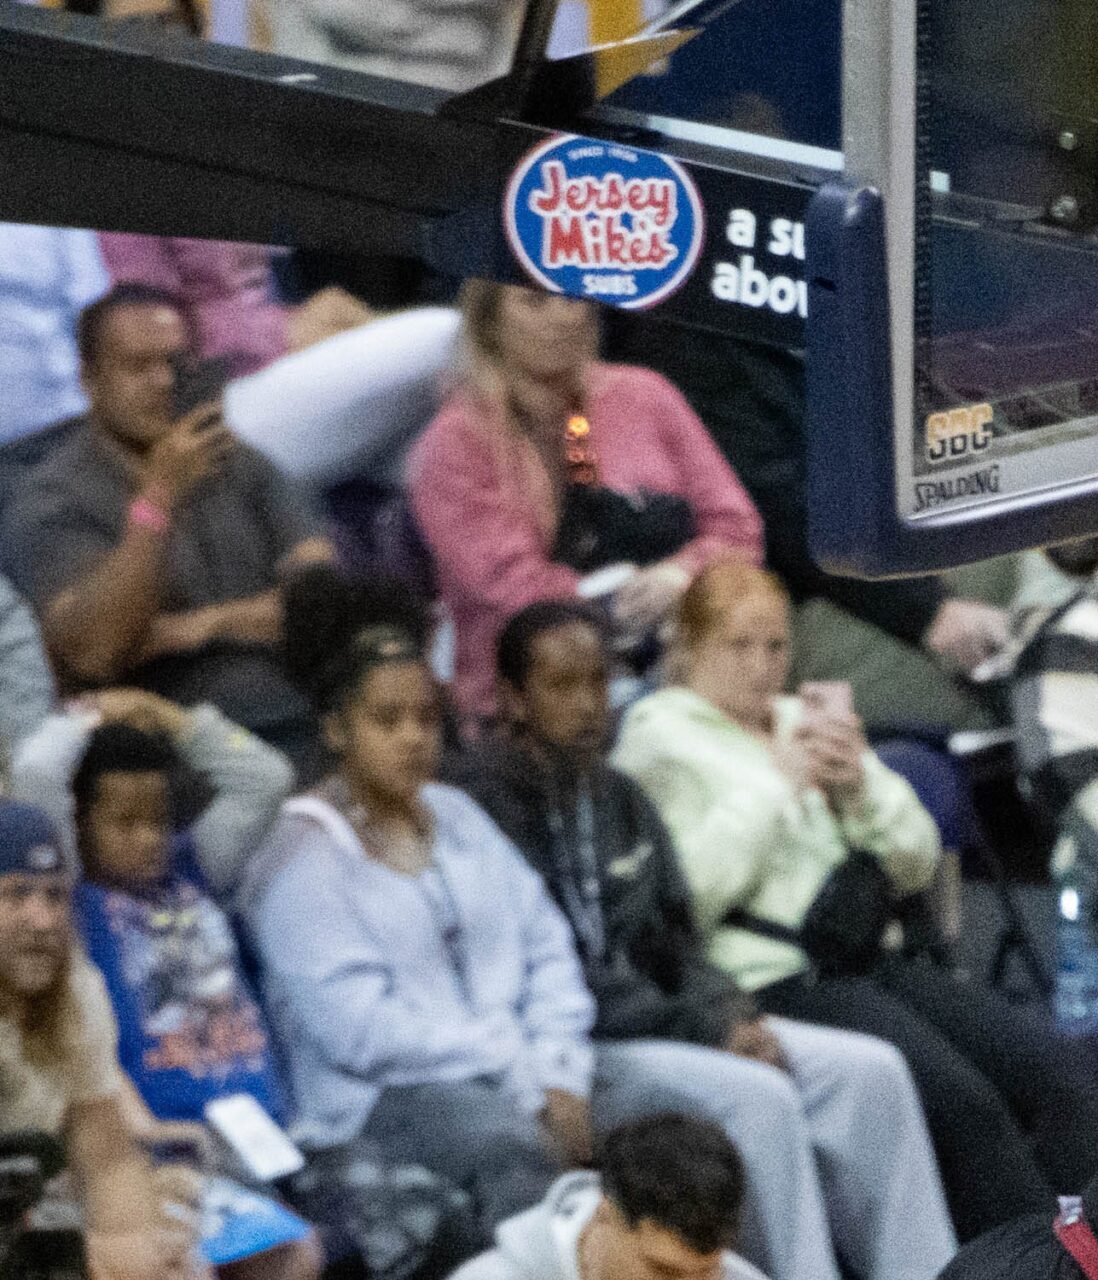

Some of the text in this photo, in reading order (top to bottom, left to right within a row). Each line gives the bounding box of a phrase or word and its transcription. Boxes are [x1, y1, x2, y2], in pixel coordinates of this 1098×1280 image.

[529, 161, 679, 229] Jersey
[726, 208, 757, 248] a
[926, 402, 994, 464] SBC
[913, 464, 1000, 512] SPALDING
